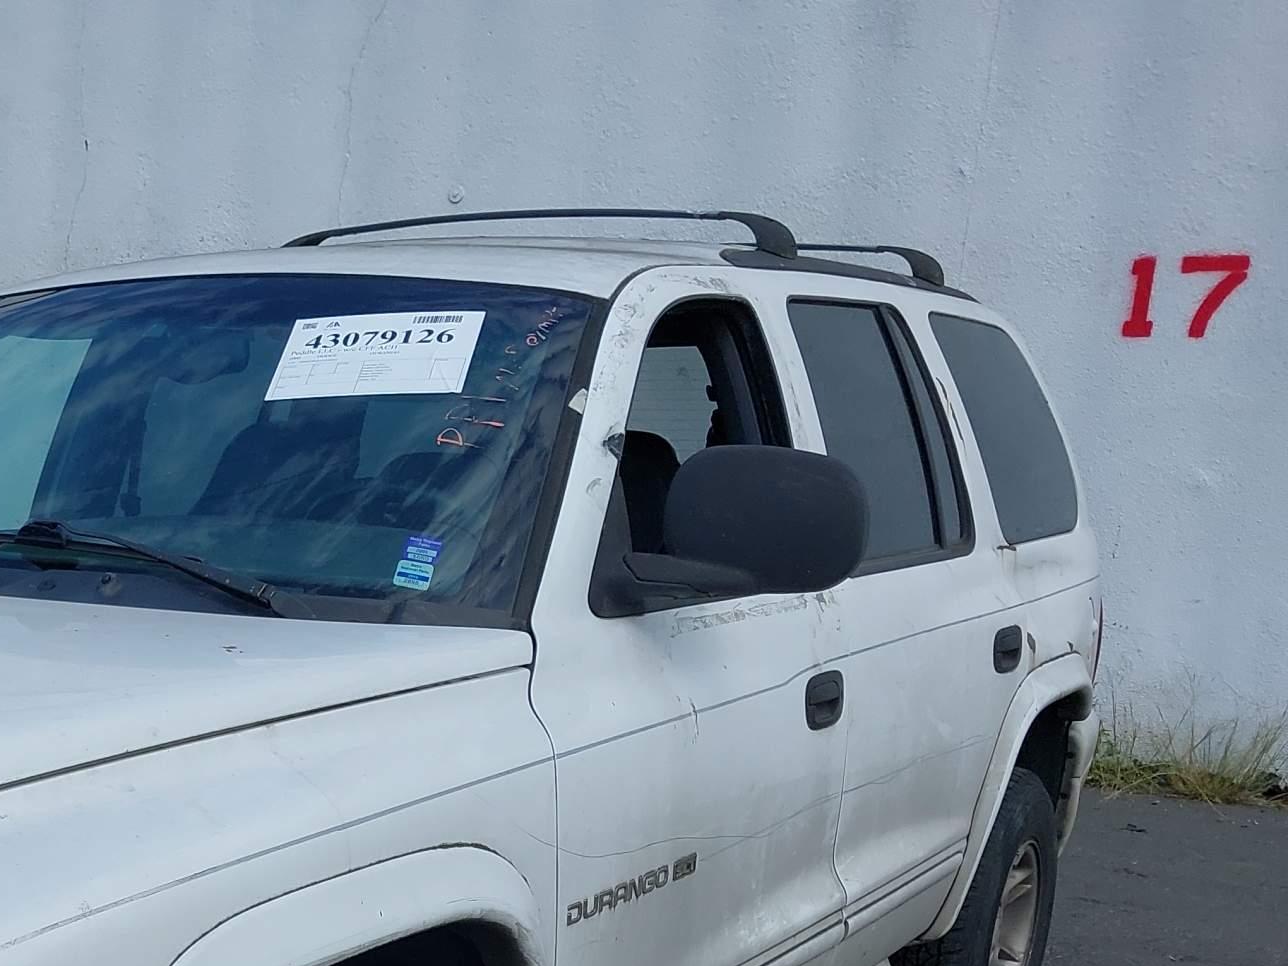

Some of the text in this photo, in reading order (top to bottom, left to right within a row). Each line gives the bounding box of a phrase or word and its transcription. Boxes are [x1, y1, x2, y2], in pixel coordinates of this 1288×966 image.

[1121, 252, 1252, 339] 17
[304, 328, 457, 349] 43079126
[567, 864, 670, 927] DURANGO
